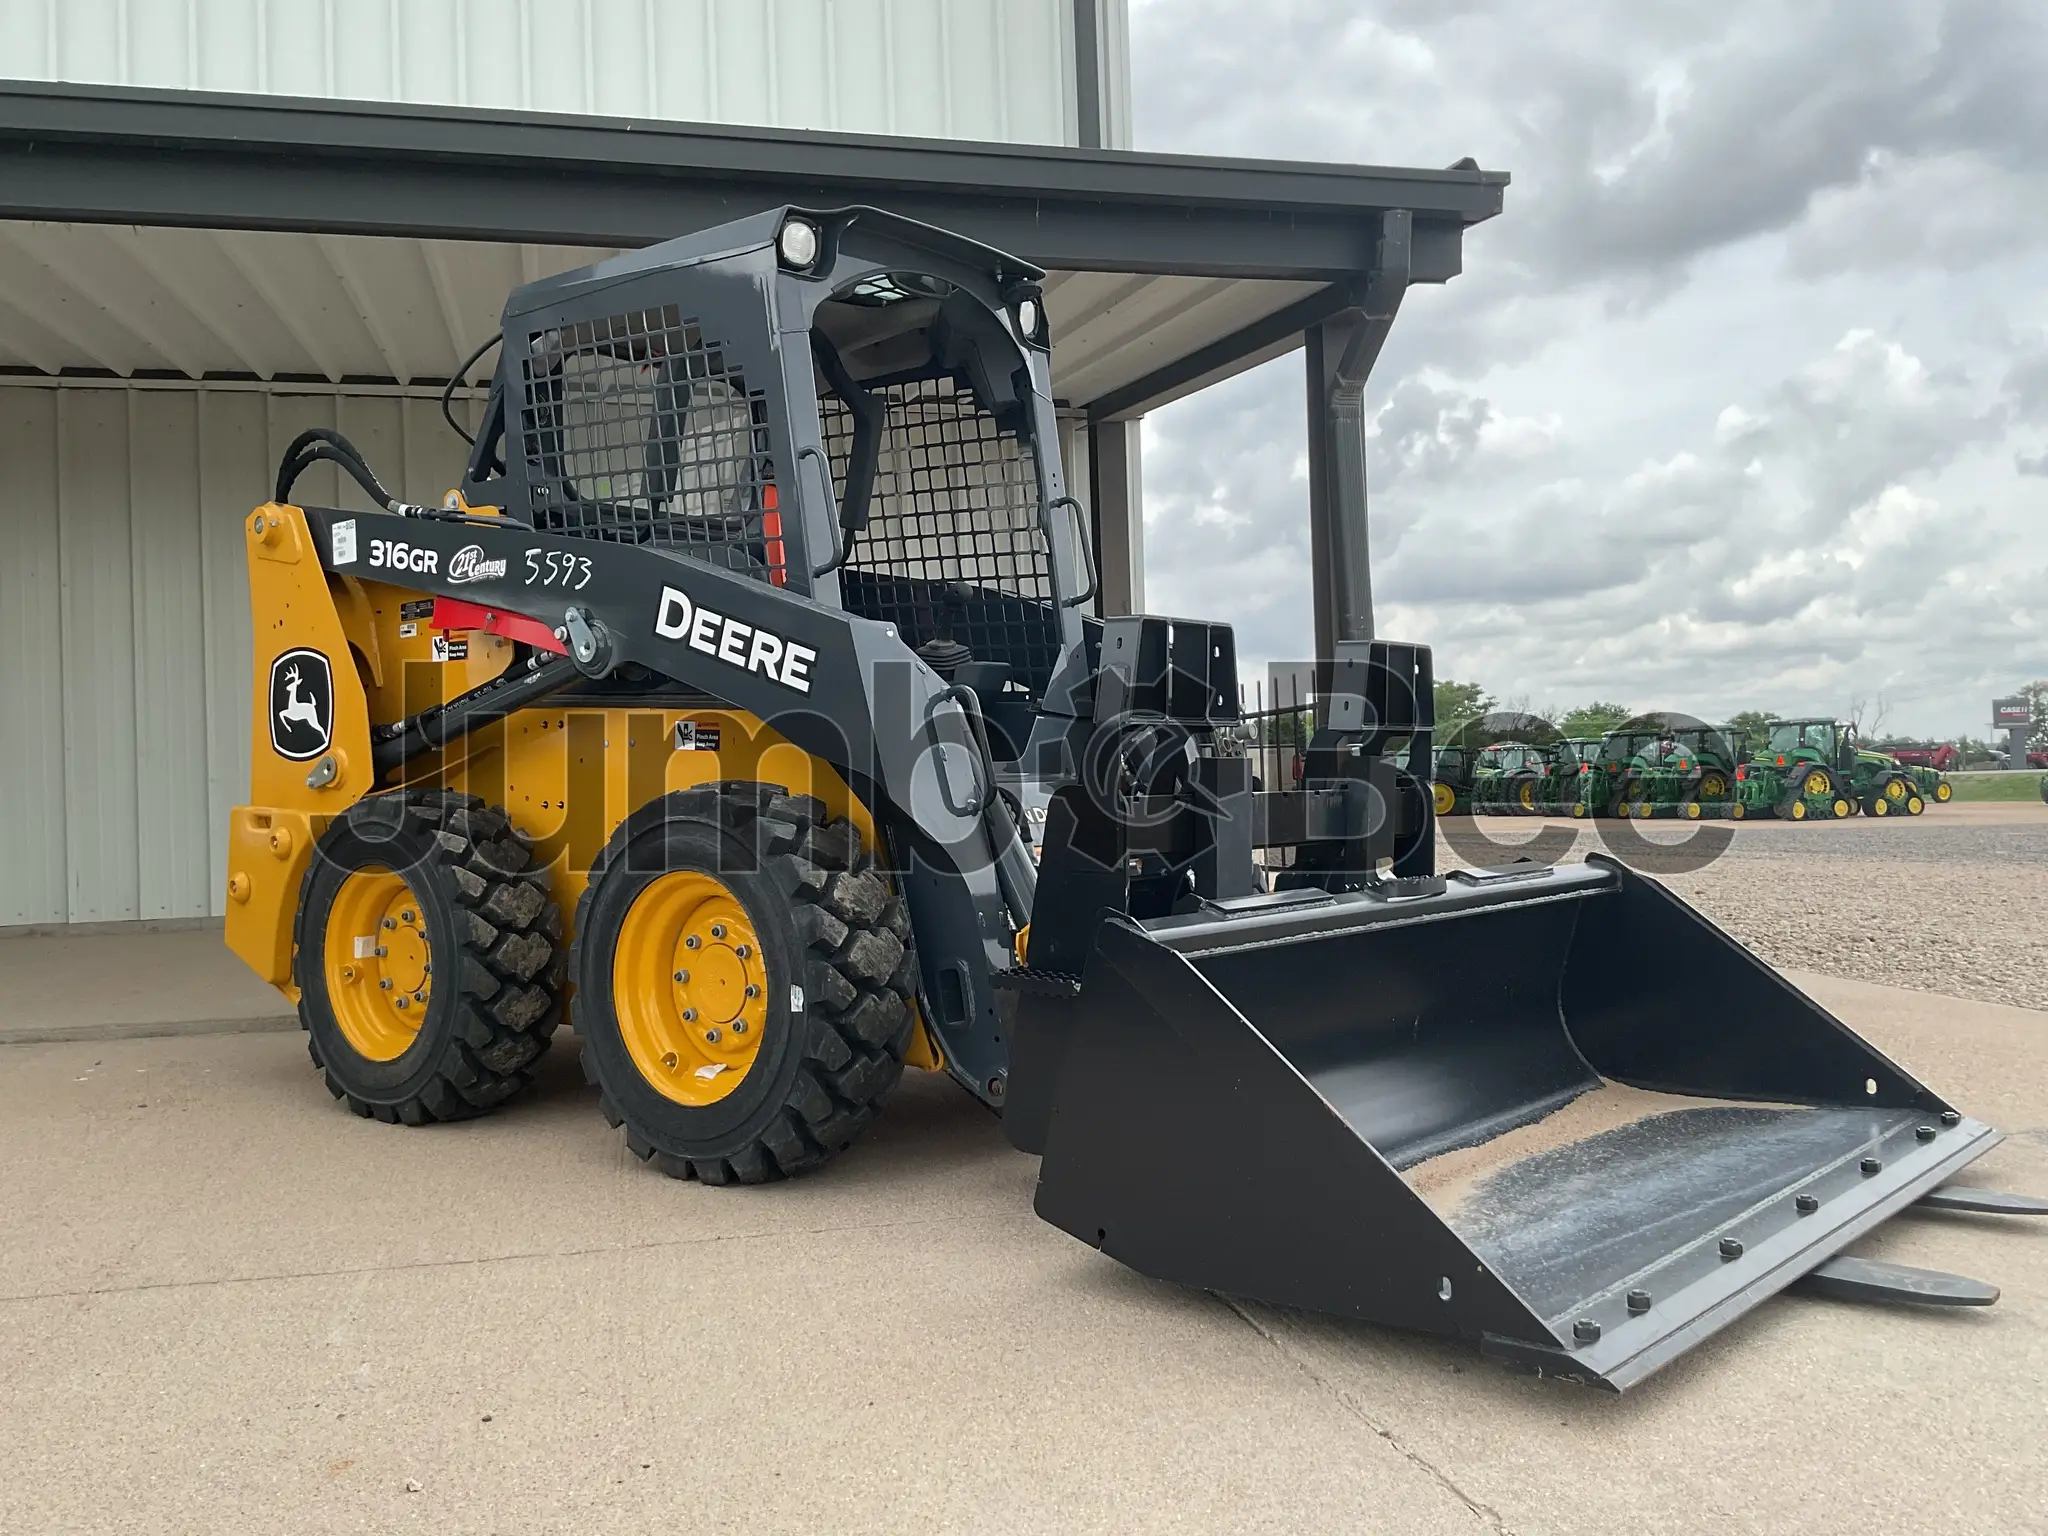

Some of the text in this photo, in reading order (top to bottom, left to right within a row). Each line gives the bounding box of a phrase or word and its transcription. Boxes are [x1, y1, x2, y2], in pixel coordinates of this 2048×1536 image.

[369, 539, 438, 575] 316GR
[525, 548, 593, 590] 5593
[655, 585, 817, 693] DEERE
